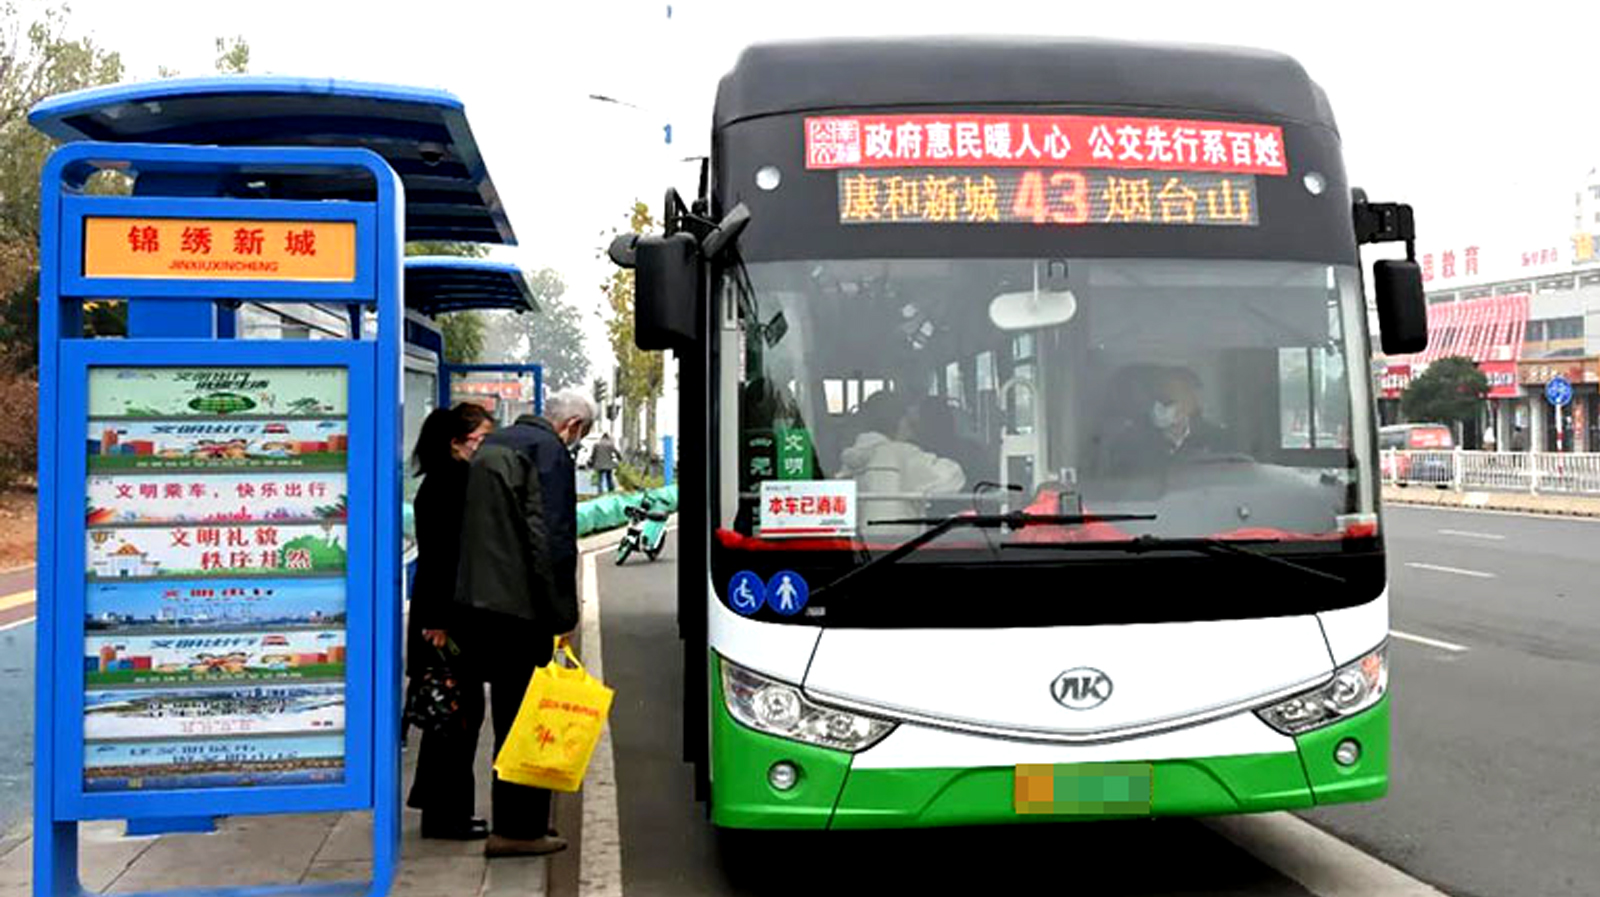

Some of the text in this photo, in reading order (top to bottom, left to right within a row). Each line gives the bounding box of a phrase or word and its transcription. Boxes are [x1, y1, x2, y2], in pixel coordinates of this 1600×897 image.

[864, 121, 1283, 167] 政府惠民暖人心 公交先行系百姓
[842, 170, 1250, 224] 康和新城 43 烟台山
[127, 225, 317, 257] 锦绣新城
[168, 259, 279, 273] JINXIUXINCHENG
[785, 434, 804, 474] 文明
[768, 495, 847, 515] 本车已消毒
[171, 526, 279, 548] 文明礼貌
